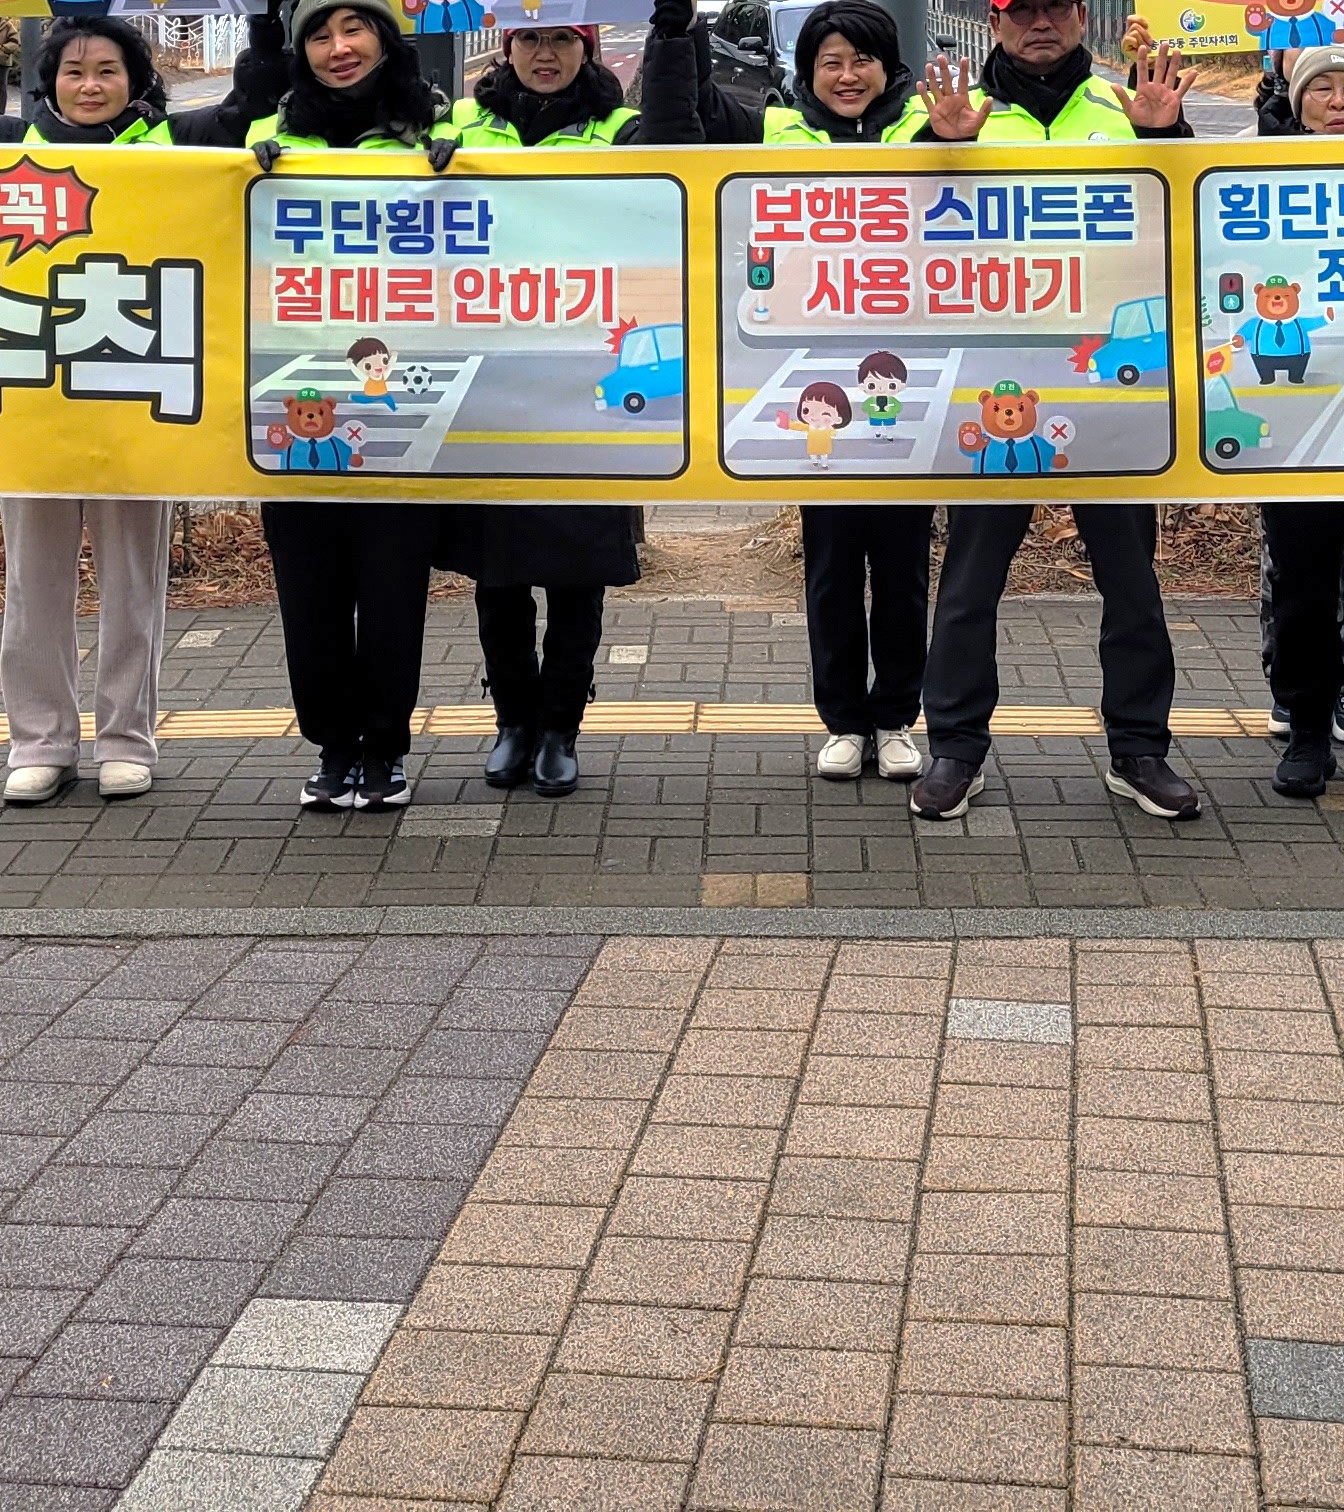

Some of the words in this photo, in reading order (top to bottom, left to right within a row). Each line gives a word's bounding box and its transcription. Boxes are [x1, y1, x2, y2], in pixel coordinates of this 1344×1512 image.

[1189, 35, 1238, 48] 주민자치회
[273, 198, 494, 256] 무단횡단
[754, 186, 910, 244] 보행중
[923, 185, 1134, 242] 스마트폰
[273, 266, 436, 324] 절대로
[453, 265, 614, 323] 안하기
[806, 258, 910, 316] 사용
[925, 256, 1082, 314] 안하기
